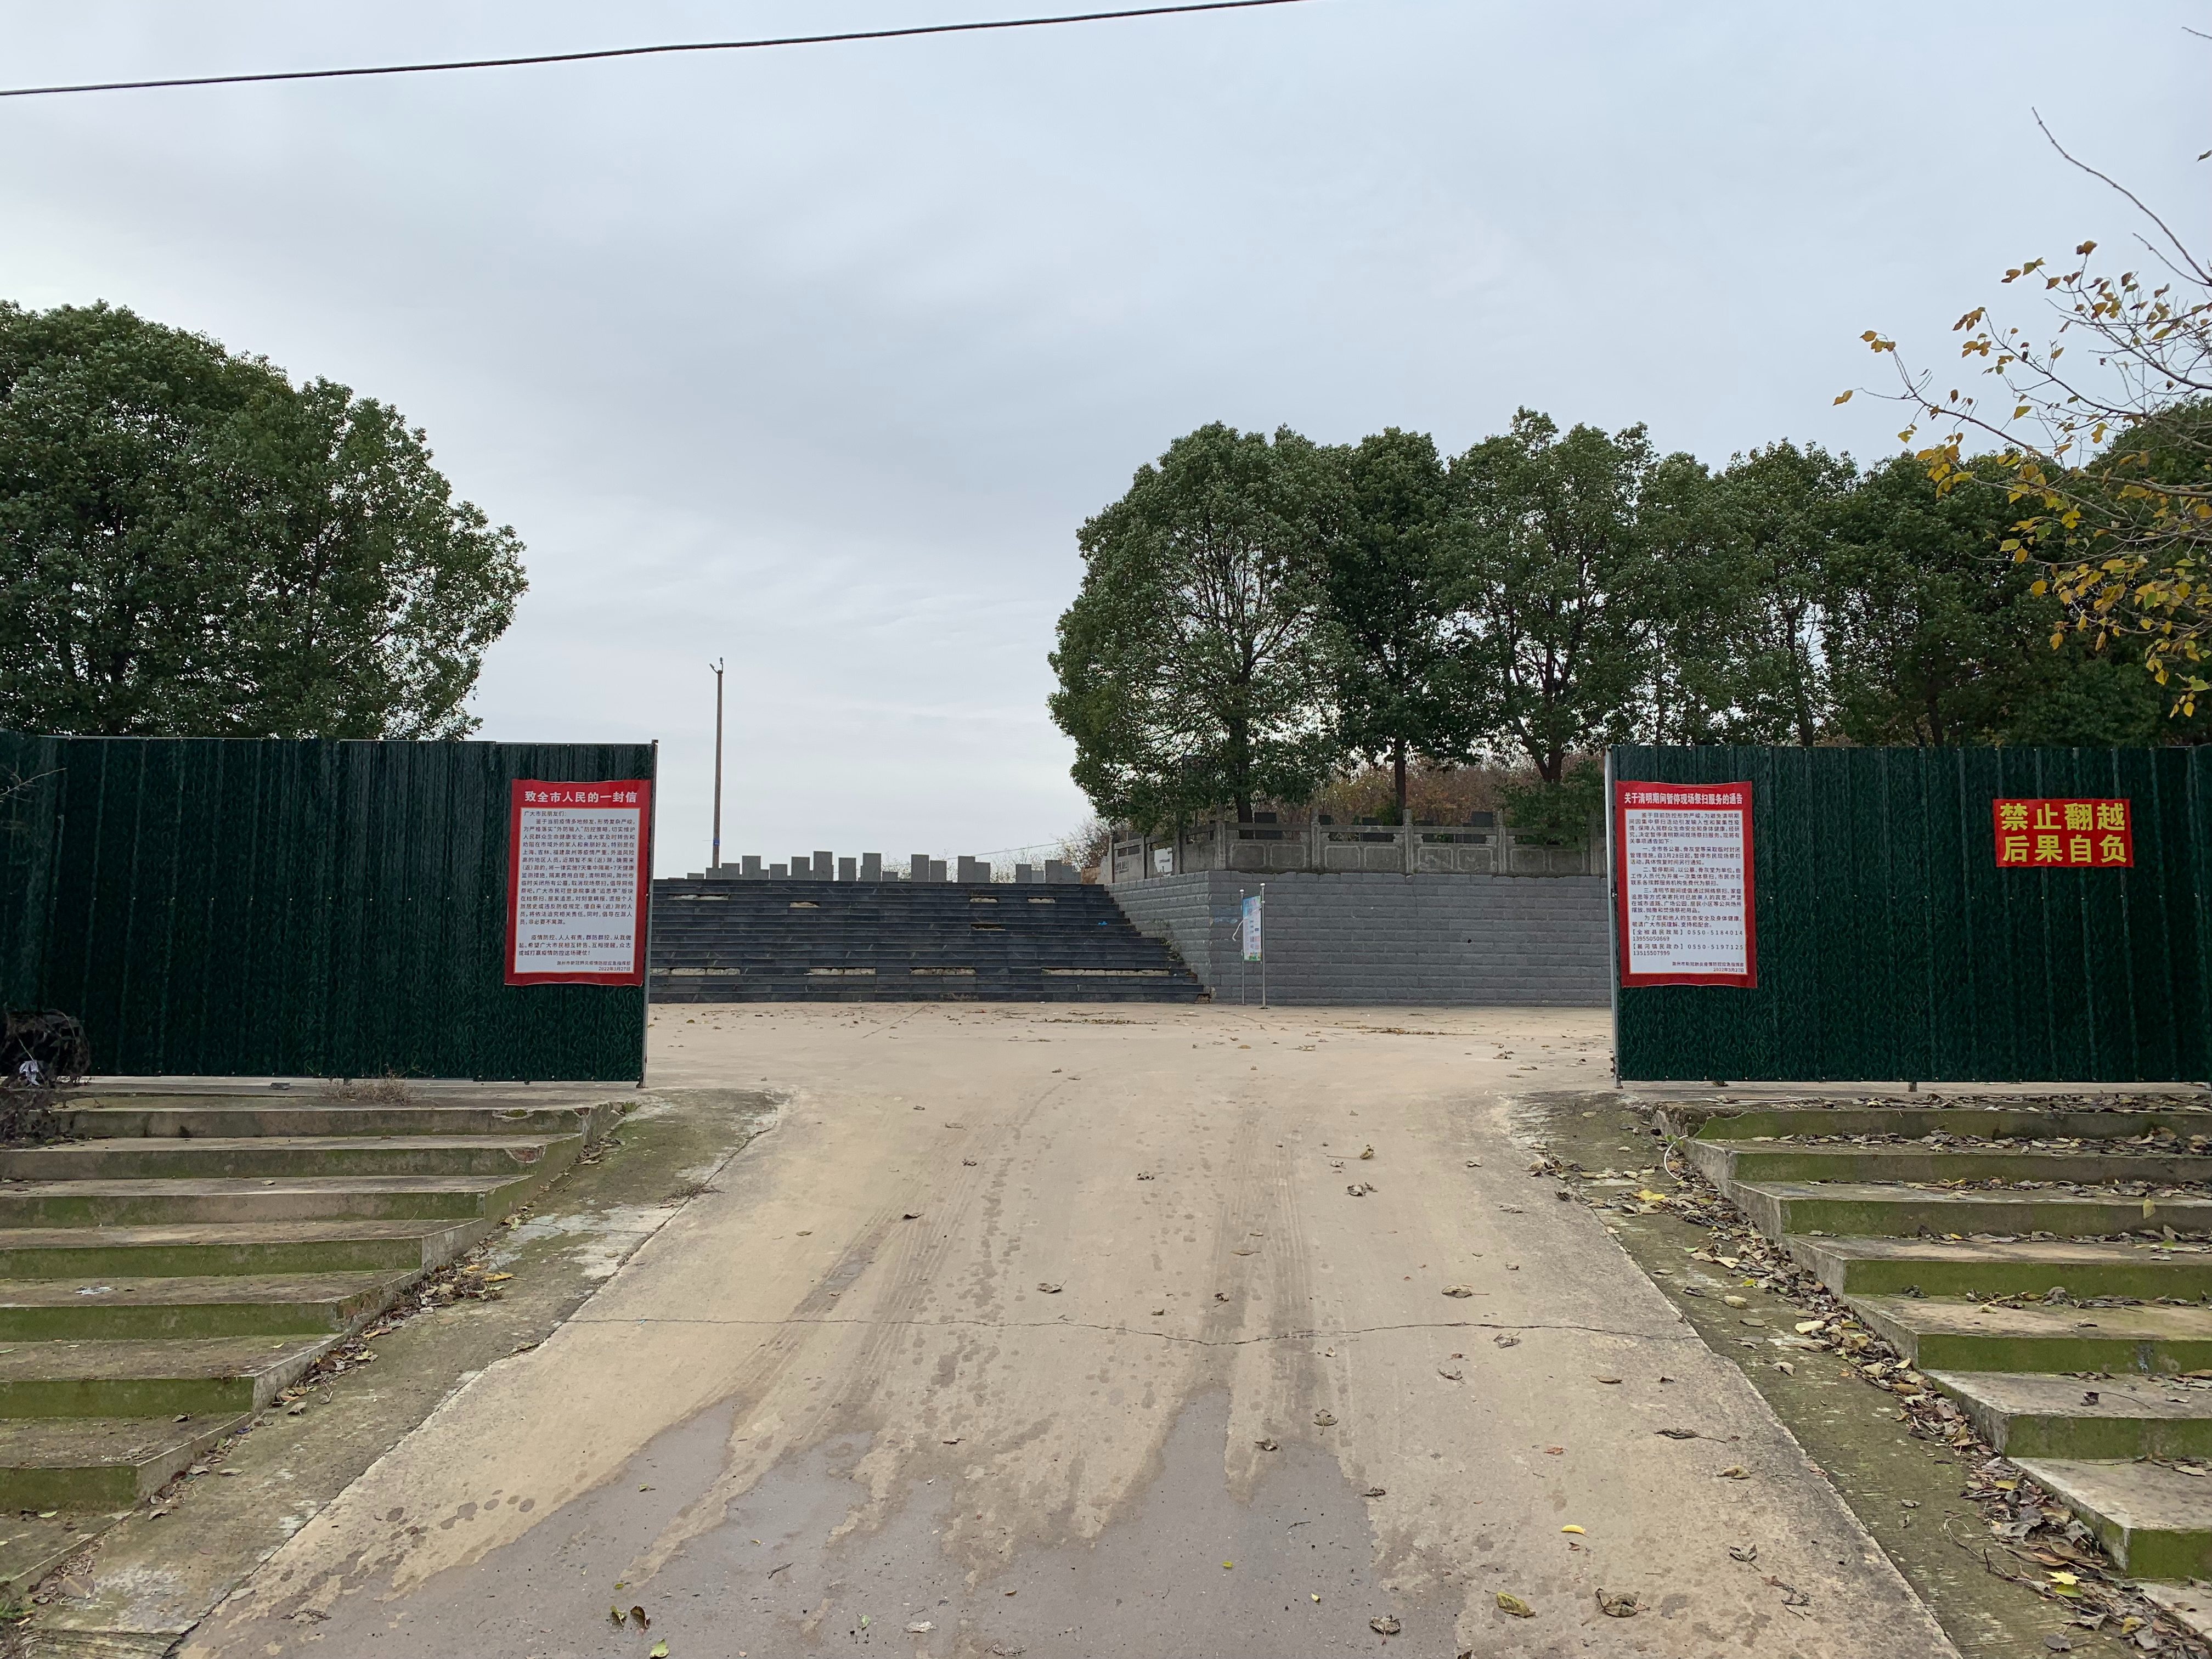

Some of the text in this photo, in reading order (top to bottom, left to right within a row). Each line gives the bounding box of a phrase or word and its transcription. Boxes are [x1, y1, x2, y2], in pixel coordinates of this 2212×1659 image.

[524, 791, 637, 803] 致全市人民的一封信
[1624, 792, 1743, 805] 关于清明期间暂停现场祭扫服务的通告
[2000, 803, 2125, 831] 禁止翻越
[2003, 834, 2126, 863] 后果自负
